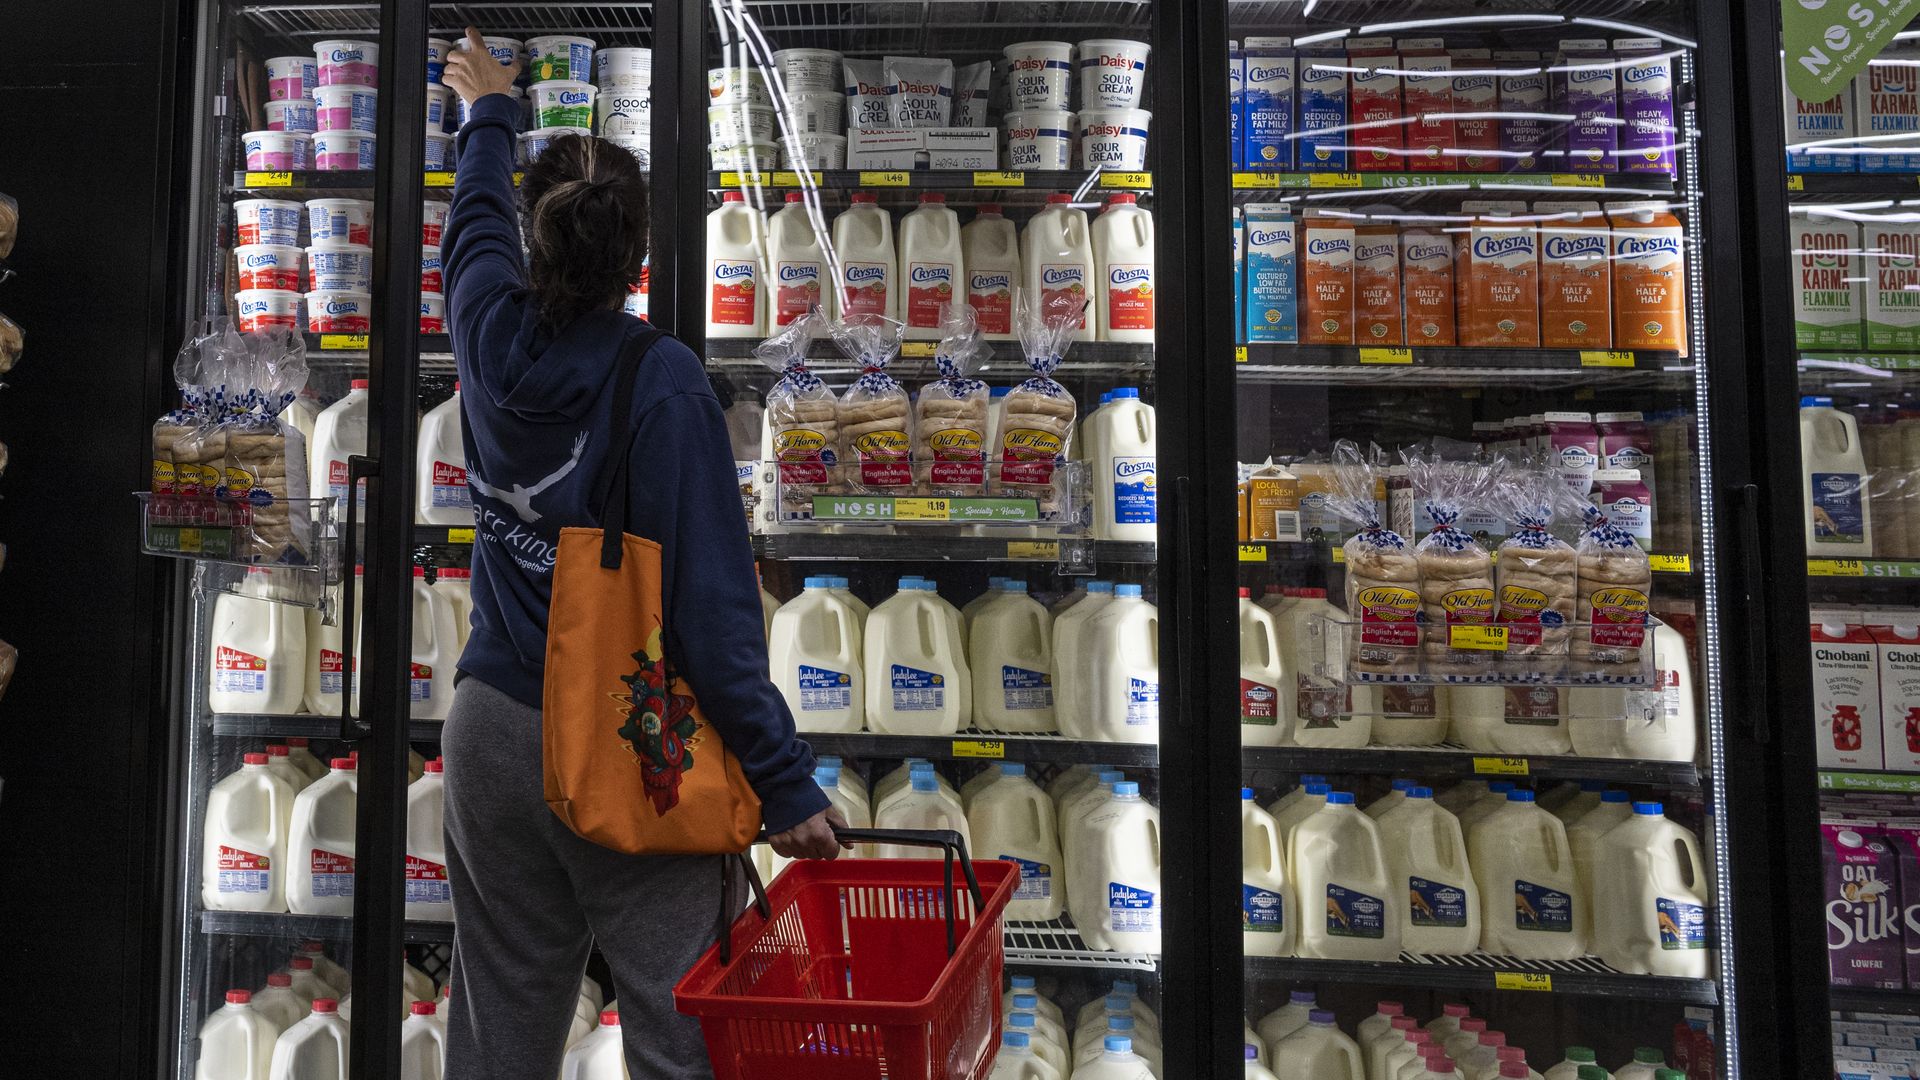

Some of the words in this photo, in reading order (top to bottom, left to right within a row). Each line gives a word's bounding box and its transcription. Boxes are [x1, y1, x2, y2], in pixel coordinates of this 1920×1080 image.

[1820, 64, 1842, 85] Natural
[1843, 43, 1865, 64] Organic
[1866, 18, 1891, 42] Specialty
[1889, 0, 1912, 17] Healthy
[332, 50, 363, 62] CRYSTAL
[1014, 57, 1048, 71] Daisy
[1101, 55, 1135, 71] Daisy
[1102, 74, 1131, 84] SOUR
[1249, 67, 1291, 83] CRYSTAL
[1624, 66, 1667, 83] CRYSTAL
[1869, 65, 1917, 93] GOOD
[1018, 77, 1045, 86] SOUR
[1502, 77, 1544, 92] CRYSTAL
[899, 81, 939, 96] Daisy
[1016, 87, 1049, 96] CREAM
[1098, 84, 1133, 94] CREAM
[560, 91, 589, 105] CRYSTAL
[903, 100, 937, 109] SOUR
[1871, 94, 1919, 114] KARMA
[614, 98, 650, 113] good
[900, 110, 940, 121] CREAM
[1798, 116, 1844, 129] FLAXMILK
[1872, 116, 1919, 130] FLAXMILK
[1010, 128, 1038, 140] Daisy
[1088, 124, 1123, 138] Daisy
[1464, 129, 1484, 137] MILK
[1513, 135, 1538, 143] CREAM
[1013, 145, 1037, 155] SOUR
[1091, 143, 1119, 153] SOUR
[1012, 154, 1040, 165] CREAM
[1382, 177, 1437, 187] NOSH
[1250, 231, 1292, 245] CRYSTAL
[1309, 239, 1350, 254] CRYSTAL
[1407, 245, 1449, 261] CRYSTAL
[1474, 236, 1534, 259] CRYSTAL
[1545, 235, 1606, 258] CRYSTAL
[1618, 235, 1679, 259] CRYSTAL
[1801, 233, 1848, 267] GOOD
[247, 254, 278, 267] CRYSTAL
[716, 264, 753, 278] CRYSTAL
[780, 266, 818, 280] CRYSTAL
[847, 267, 885, 281] CRYSTAL
[911, 266, 950, 281] CRYSTAL
[1044, 269, 1082, 284] CRYSTAL
[1111, 269, 1150, 283] CRYSTAL
[972, 275, 1009, 289] CRYSTAL
[1802, 270, 1850, 290] KARMA
[1316, 285, 1337, 293] HALF
[1491, 286, 1512, 294] HALF
[1562, 287, 1584, 295] HALF
[1636, 287, 1658, 296] HALF
[1321, 293, 1341, 301] HALF
[1495, 294, 1517, 302] HALF
[1567, 295, 1588, 303] HALF
[1641, 295, 1662, 303] HALF
[1803, 291, 1850, 306] FLAXMILK
[327, 302, 358, 314] CRYSTAL
[793, 435, 822, 447] Home
[861, 436, 881, 447] Old
[883, 435, 908, 447] Home
[933, 433, 952, 446] Old
[1006, 432, 1027, 444] Old
[1028, 435, 1059, 449] Home
[154, 467, 175, 479] Home
[435, 464, 460, 479] LadyLee
[1117, 462, 1155, 476] CRYSTAL
[227, 476, 250, 487] Home
[1256, 481, 1279, 490] LOCAL
[834, 503, 891, 515] NOSH
[928, 501, 945, 510] $1.19
[965, 506, 993, 516] Specialty
[1000, 507, 1026, 516] Healthy
[153, 535, 175, 545] NOSH
[505, 525, 557, 565] king
[515, 555, 549, 573] together
[1363, 592, 1386, 603] Old
[1388, 593, 1417, 606] Home
[1446, 595, 1469, 607] Old
[1513, 593, 1545, 605] Home
[1595, 593, 1616, 604] Old
[1619, 595, 1647, 606] Home
[1484, 628, 1503, 637] $1.19
[218, 649, 243, 667] LadyLee
[1816, 650, 1870, 661] Chobani
[800, 669, 824, 686] LadyLee
[893, 668, 917, 686] LadyLee
[1003, 670, 1027, 687] LadyLee
[1825, 676, 1849, 685] Lactose
[1850, 676, 1863, 685] Free
[1840, 684, 1860, 692] Protein
[1843, 778, 1870, 786] Natural
[1876, 779, 1903, 789] Organic
[220, 850, 245, 867] LadyLee
[313, 853, 338, 871] LadyLee
[1842, 865, 1877, 881] OAT
[1111, 887, 1137, 906] LadyLee
[1826, 895, 1900, 950] Silk
[1851, 959, 1883, 969] LOWFAT
